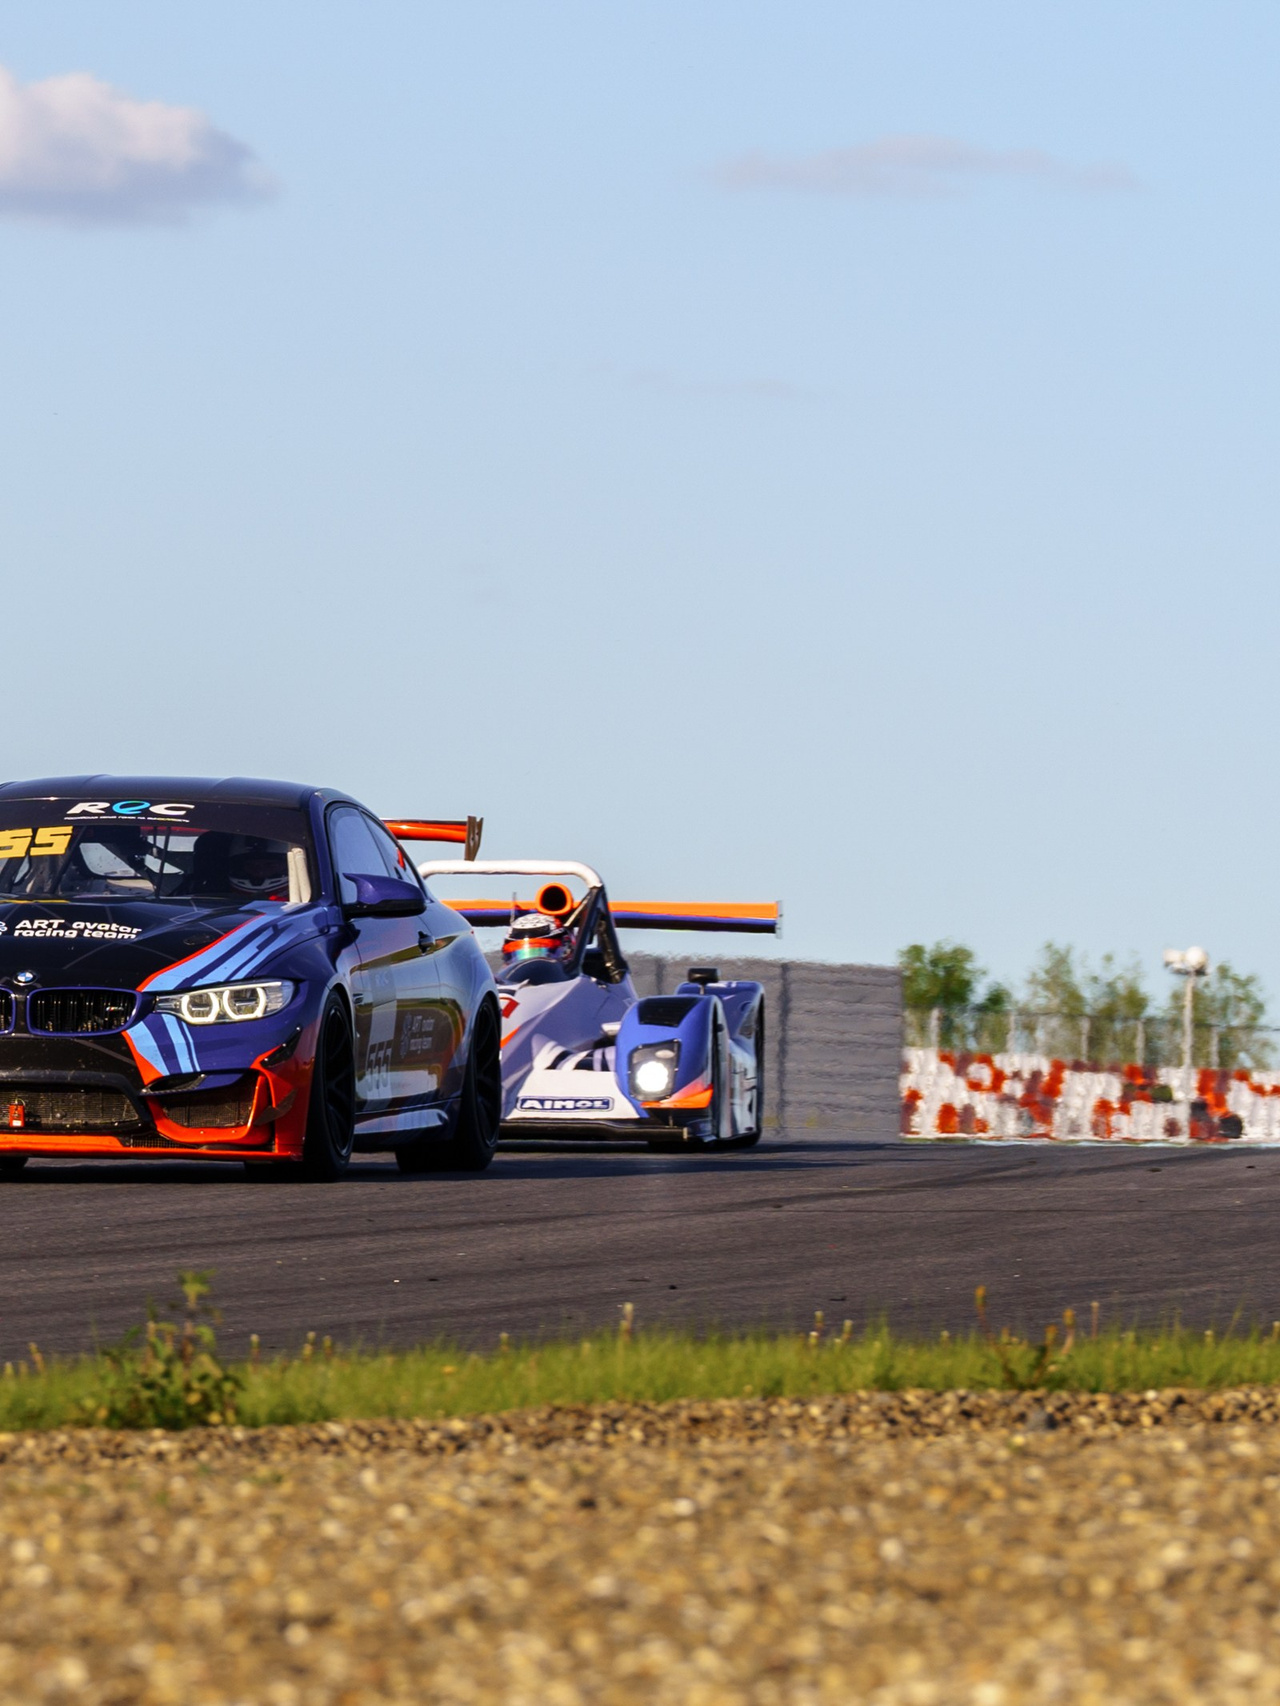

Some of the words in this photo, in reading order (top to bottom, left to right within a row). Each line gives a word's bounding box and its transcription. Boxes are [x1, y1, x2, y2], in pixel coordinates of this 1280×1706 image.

[15, 919, 65, 929] ART
[72, 921, 142, 934] avatar
[13, 928, 78, 938] racing
[83, 928, 137, 939] team
[521, 1099, 609, 1109] AIMOL
